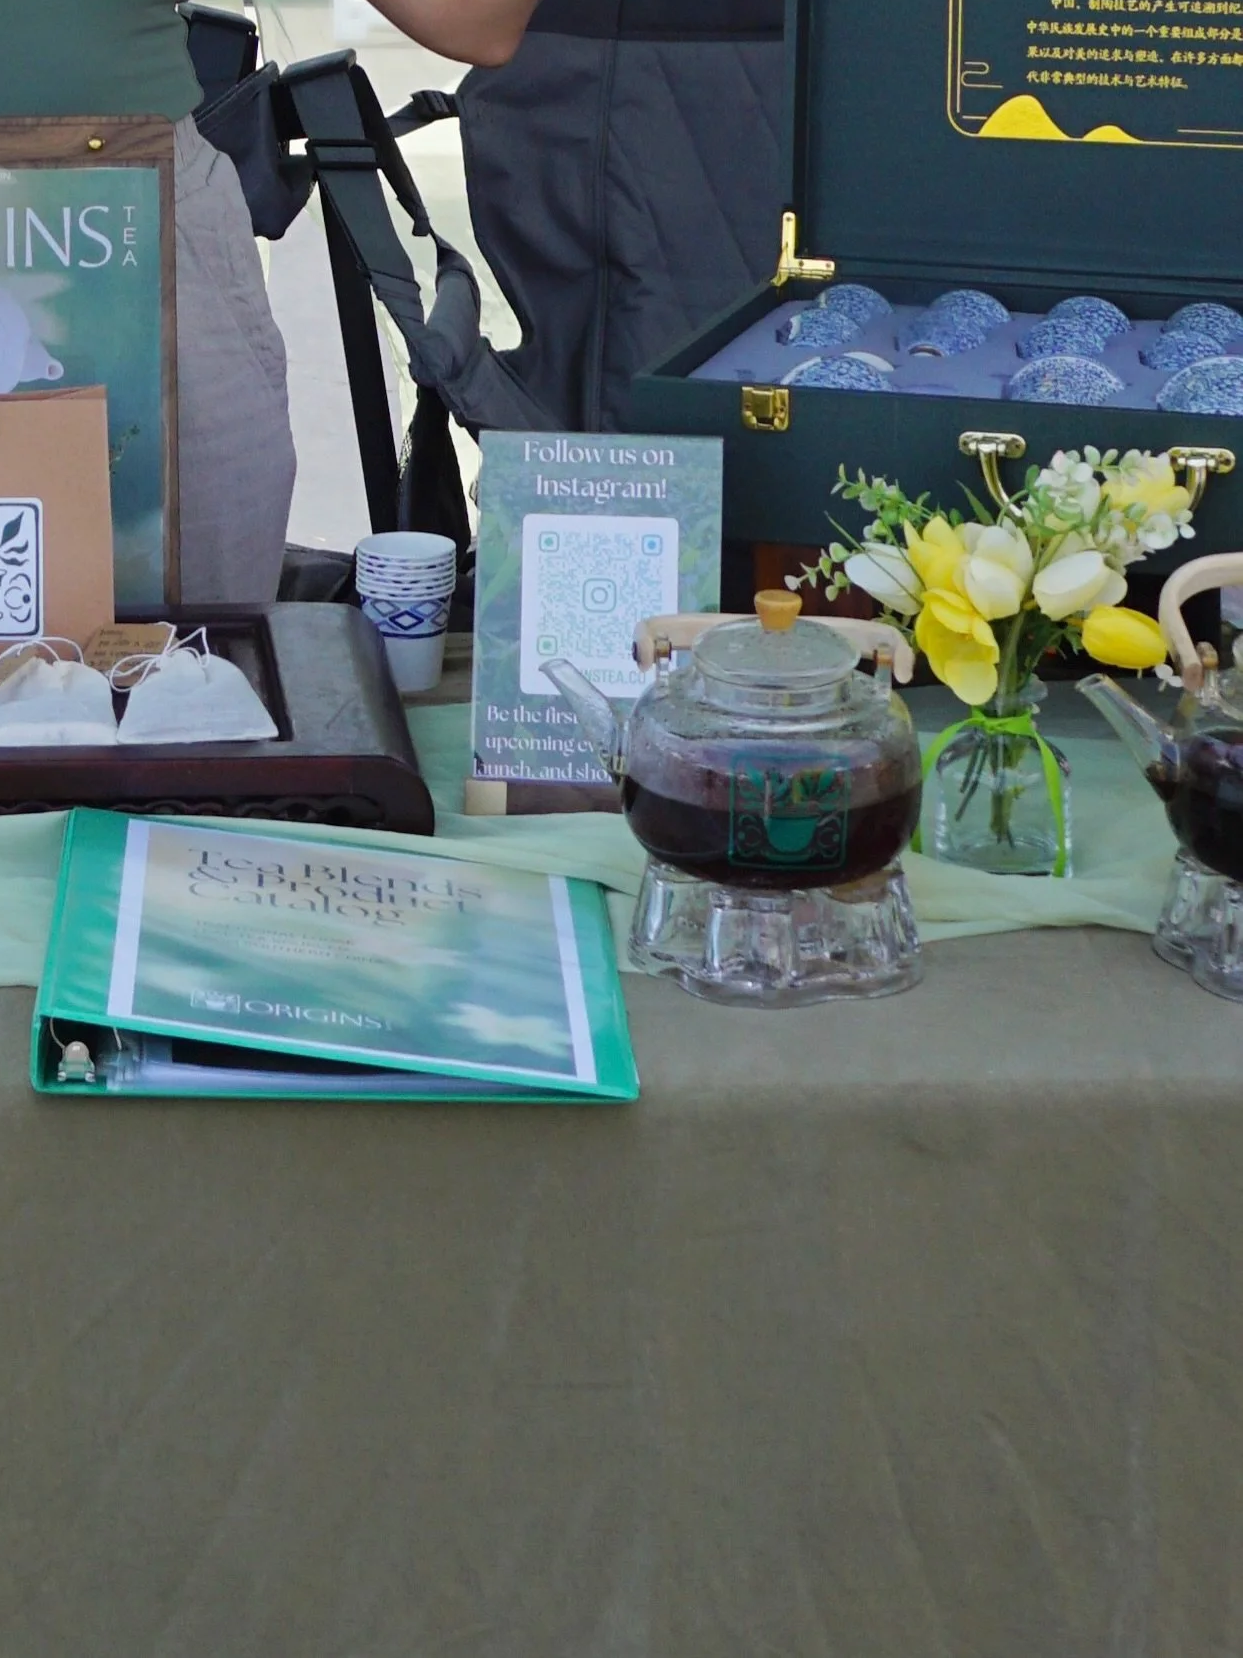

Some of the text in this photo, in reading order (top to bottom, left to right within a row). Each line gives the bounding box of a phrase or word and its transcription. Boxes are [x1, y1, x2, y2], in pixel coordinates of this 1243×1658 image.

[122, 206, 138, 267] TEA
[524, 439, 676, 466] Follow us on
[536, 474, 668, 504] Instagram!
[487, 704, 509, 722] Be
[513, 704, 542, 723] the
[485, 735, 575, 757] upcoming
[539, 761, 573, 780] and
[188, 847, 483, 900] Tea Blends
[188, 882, 406, 926] Catalog
[256, 872, 467, 913] Product
[244, 998, 383, 1030] ORIGINS
